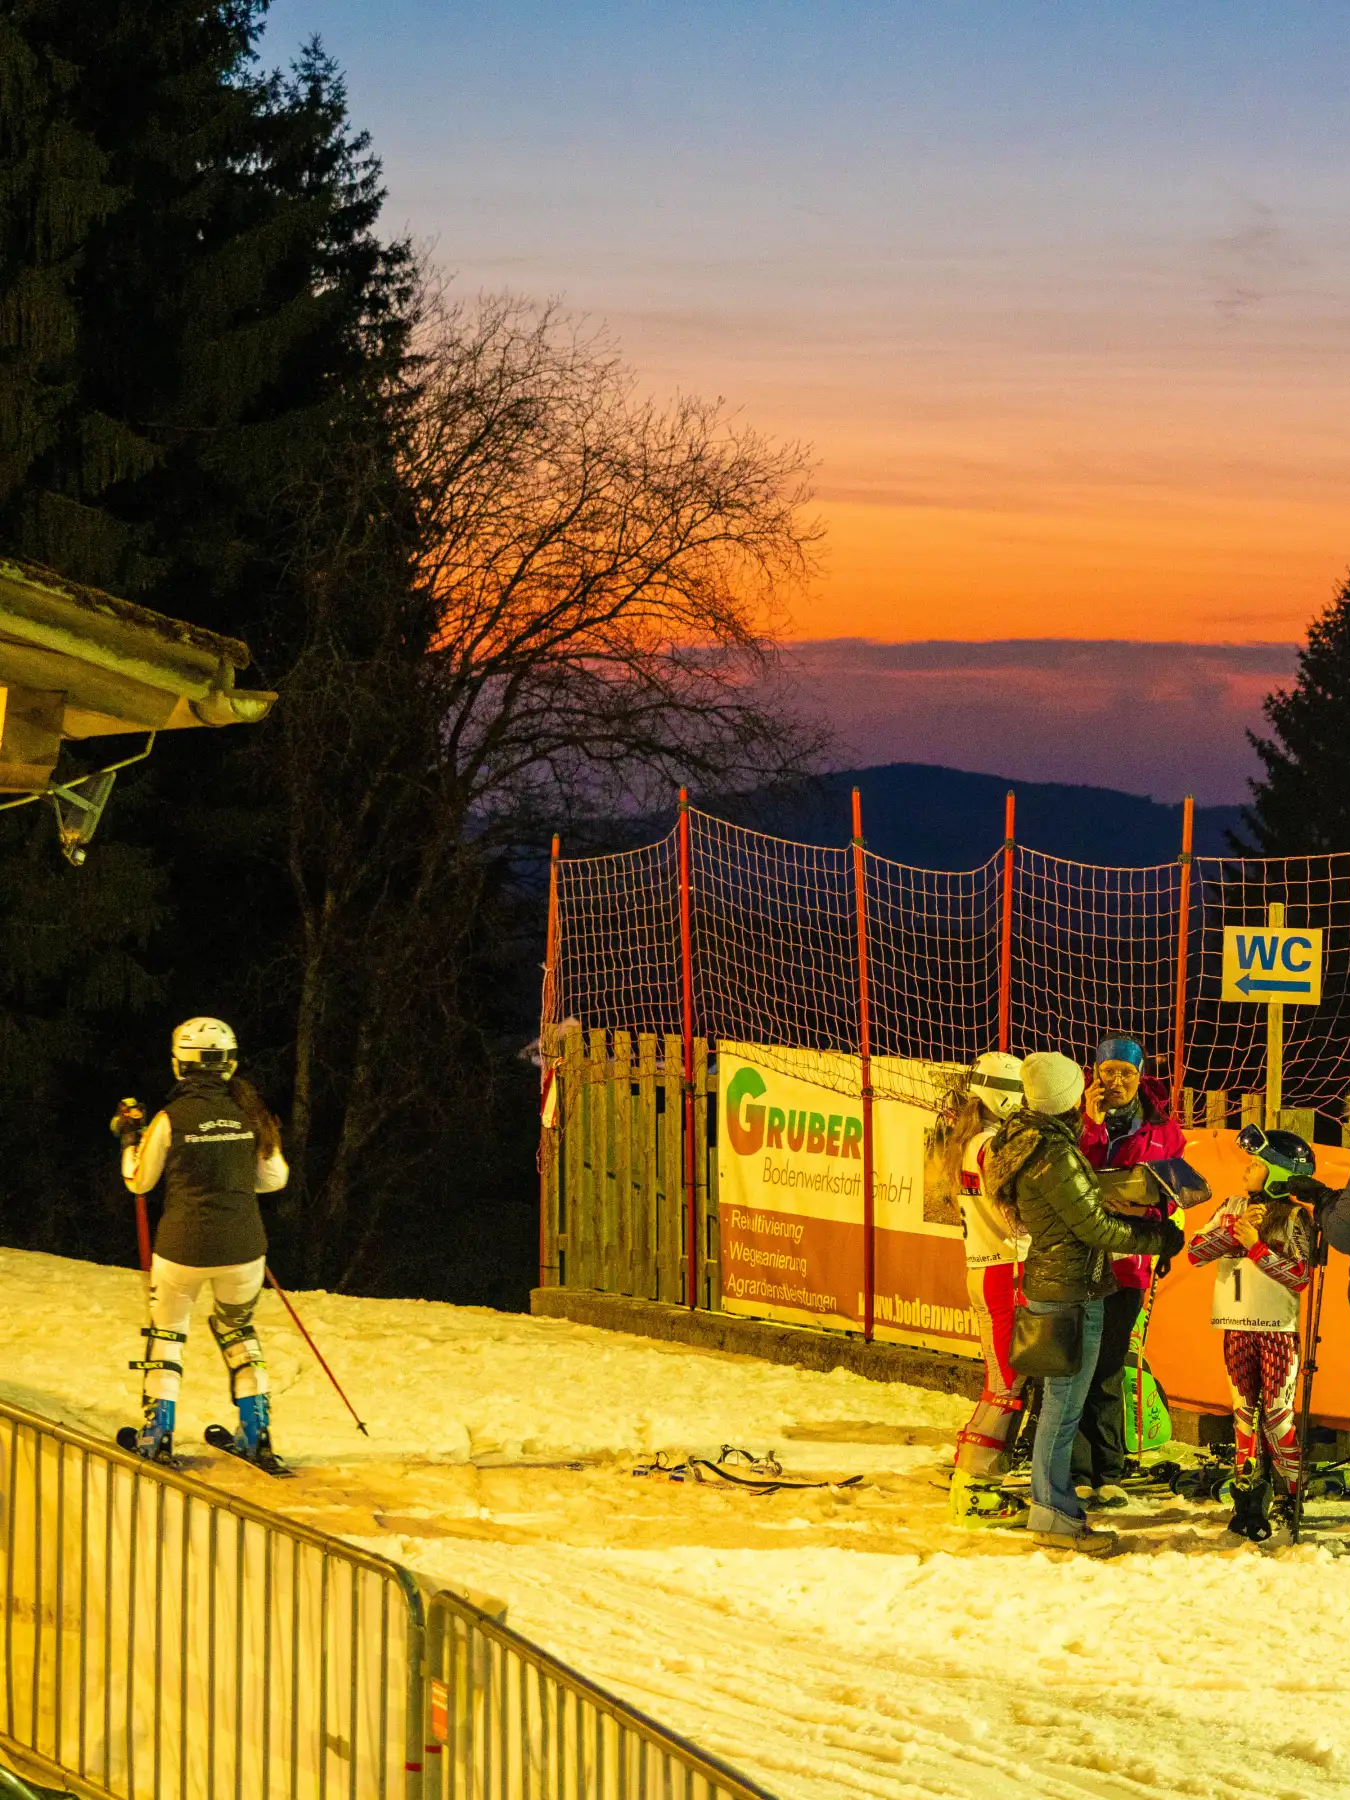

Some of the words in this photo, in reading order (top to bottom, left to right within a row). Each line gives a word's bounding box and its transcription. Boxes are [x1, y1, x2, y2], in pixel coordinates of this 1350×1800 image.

[1236, 934, 1312, 972] WC
[726, 1066, 863, 1160] GRUBER
[763, 1157, 863, 1197] Bodenwerkstatt
[1232, 1267, 1242, 1302] 1
